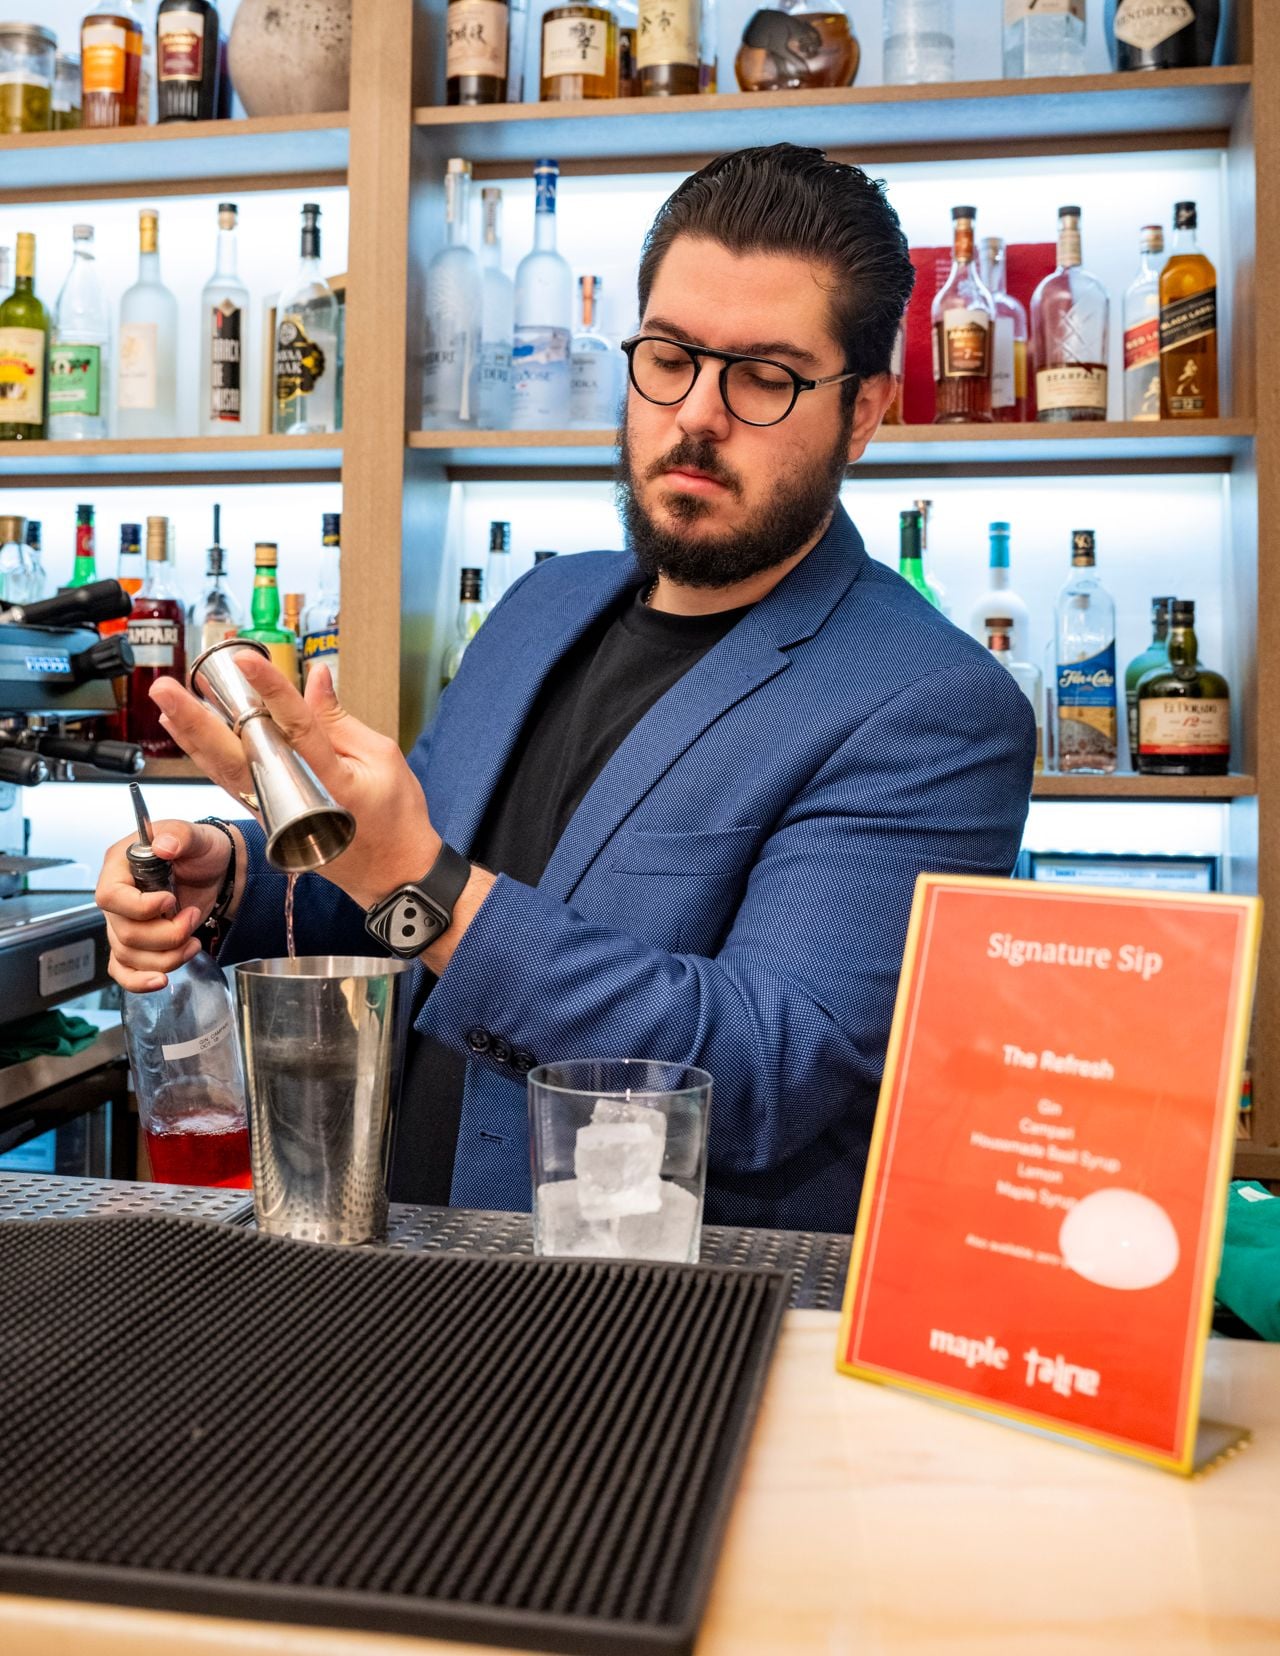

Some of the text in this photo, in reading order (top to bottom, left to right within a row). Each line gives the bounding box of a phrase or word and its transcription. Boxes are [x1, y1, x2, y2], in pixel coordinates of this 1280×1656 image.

[1160, 313, 1188, 331] BLACK
[127, 626, 179, 645] AMPARI
[987, 932, 1164, 982] Signature Sip
[1002, 1043, 1115, 1081] The Refresh
[1036, 1097, 1063, 1117] Gin
[1018, 1116, 1076, 1141] Campari
[1016, 1161, 1064, 1184] Lemon
[1079, 1149, 1122, 1174] Syrup
[995, 1178, 1079, 1210] Maple Syru
[929, 1330, 1010, 1369] maple
